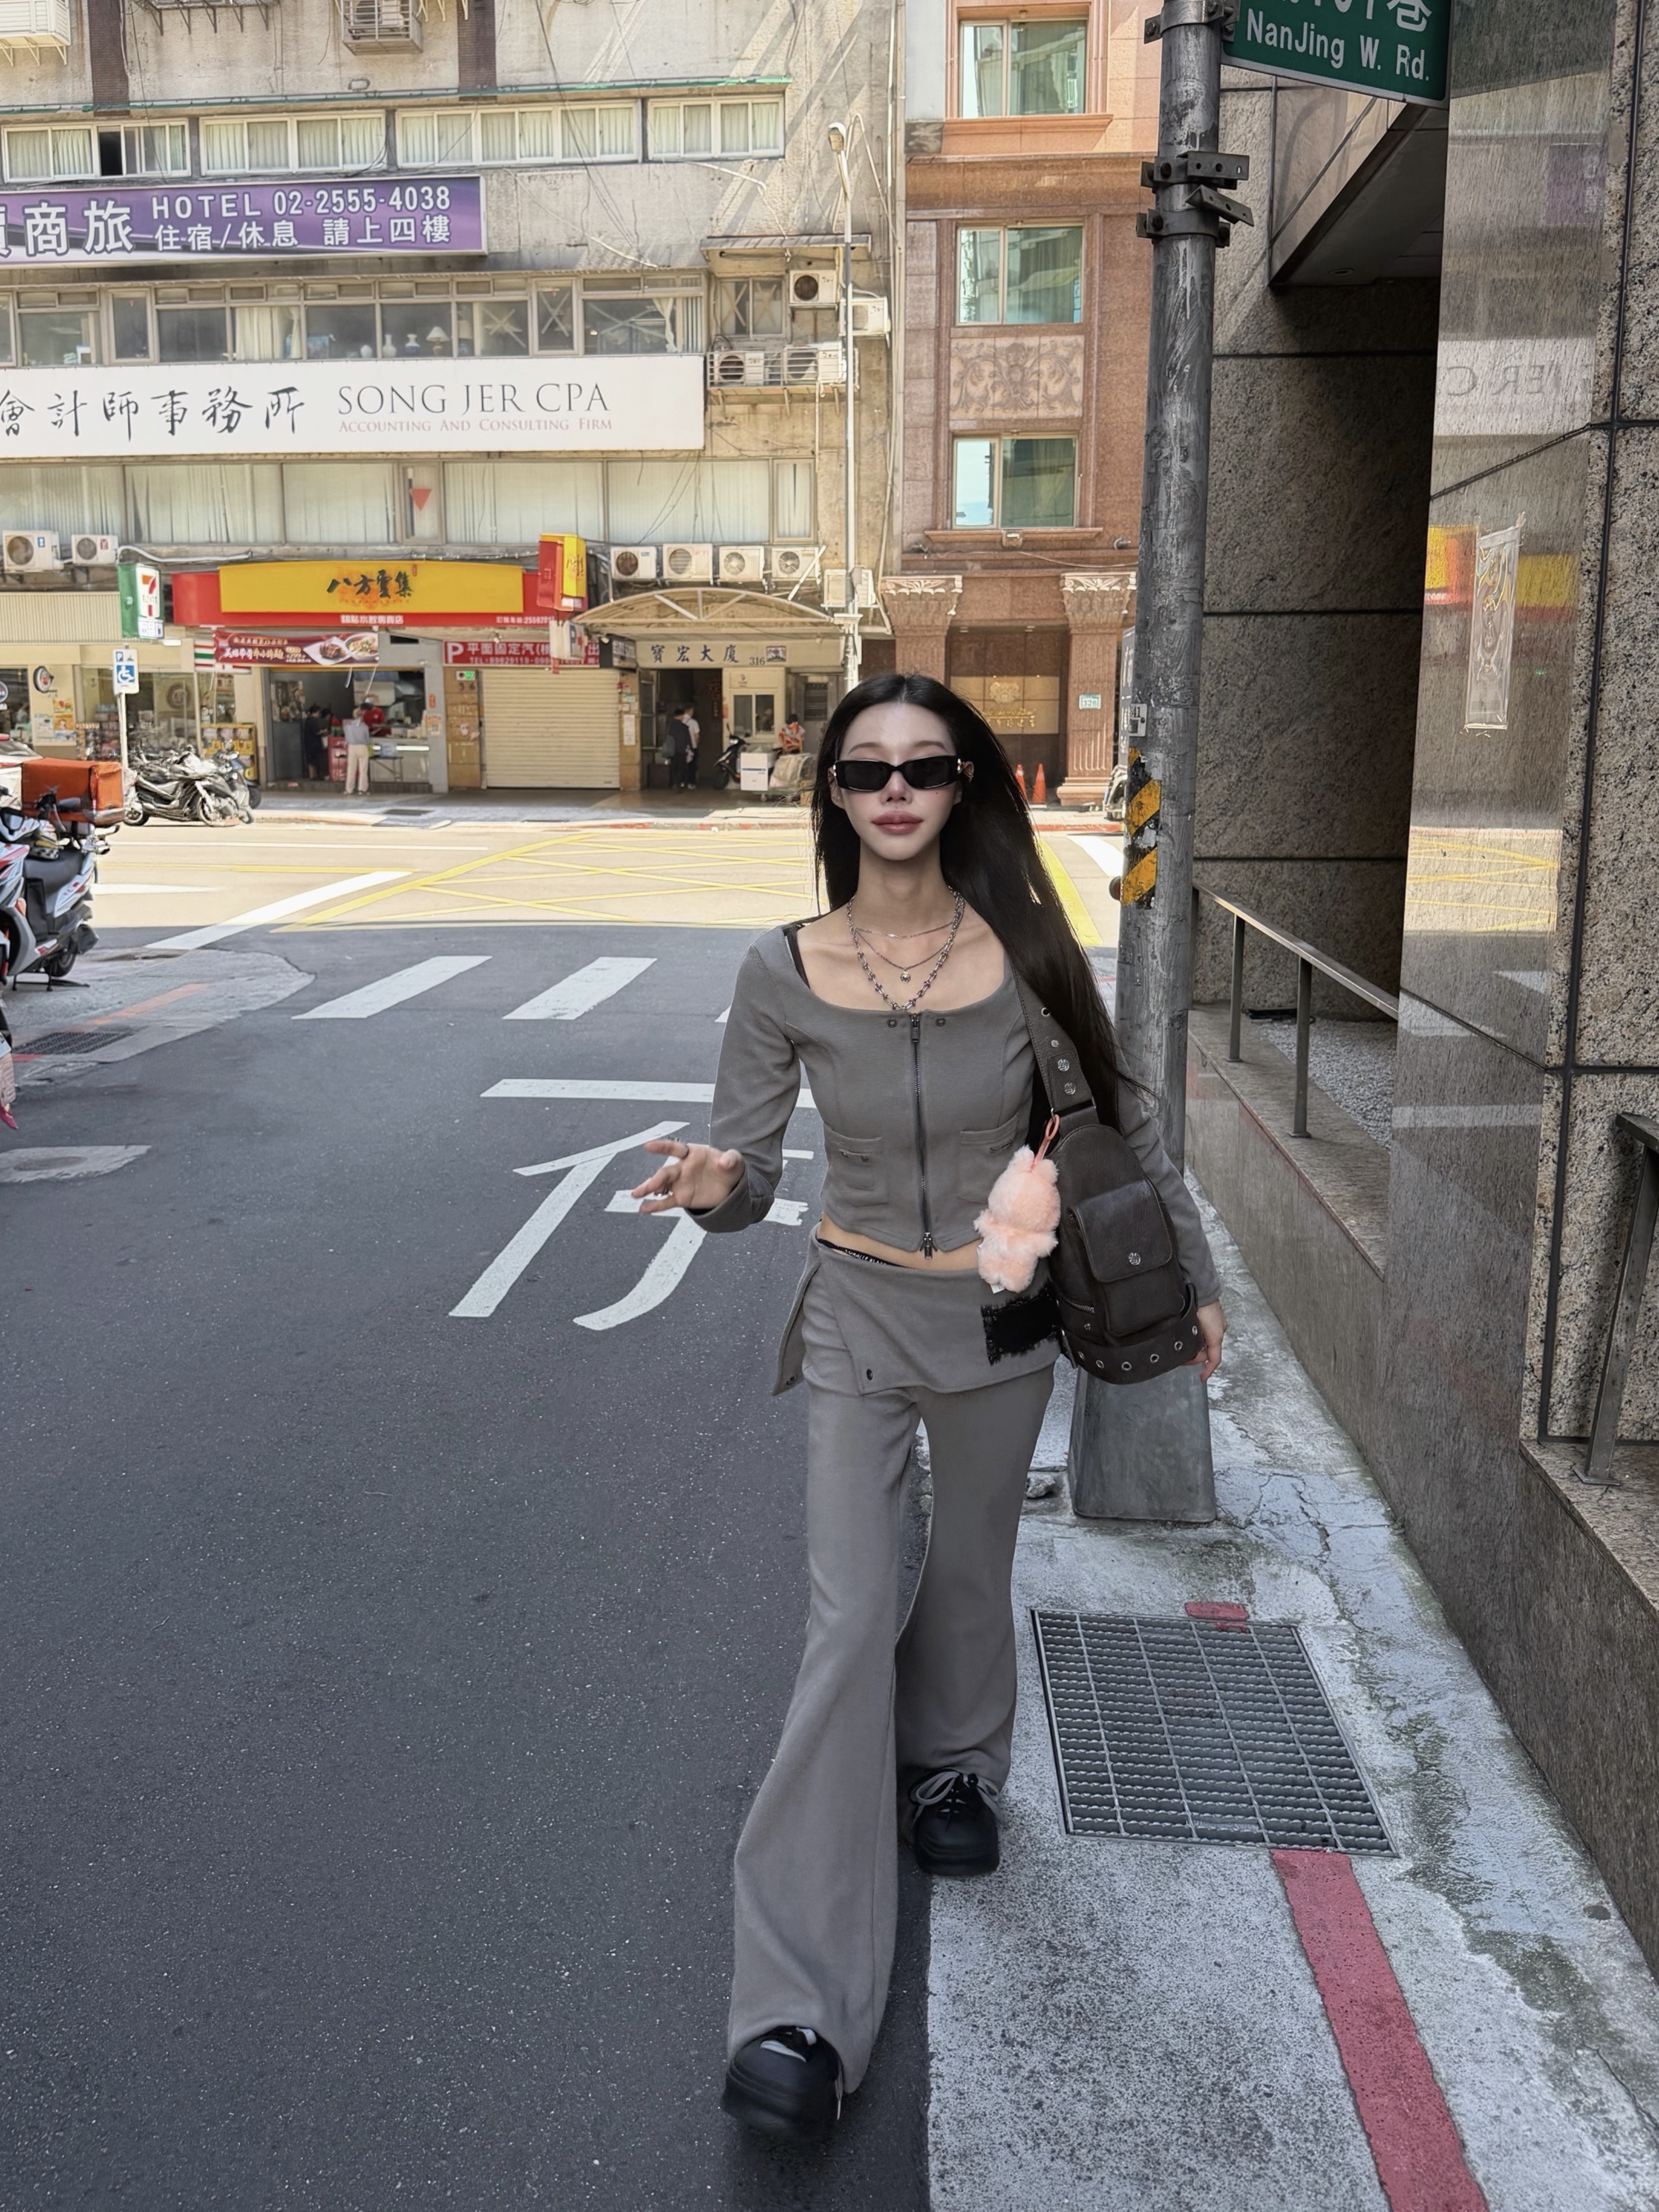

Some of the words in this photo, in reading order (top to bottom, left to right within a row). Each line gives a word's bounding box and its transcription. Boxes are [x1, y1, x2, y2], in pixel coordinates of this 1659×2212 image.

[1247, 8, 1344, 68] NanJing
[1396, 44, 1429, 81] Rd.
[152, 193, 262, 219] HOTEL
[273, 185, 451, 215] 02-2555-4038
[154, 219, 299, 251] 住宿/休息
[323, 214, 451, 246] 請上四樓
[338, 384, 447, 415] SONG
[462, 384, 526, 416] JER
[536, 383, 611, 413] CPA
[750, 657, 765, 666] 316
